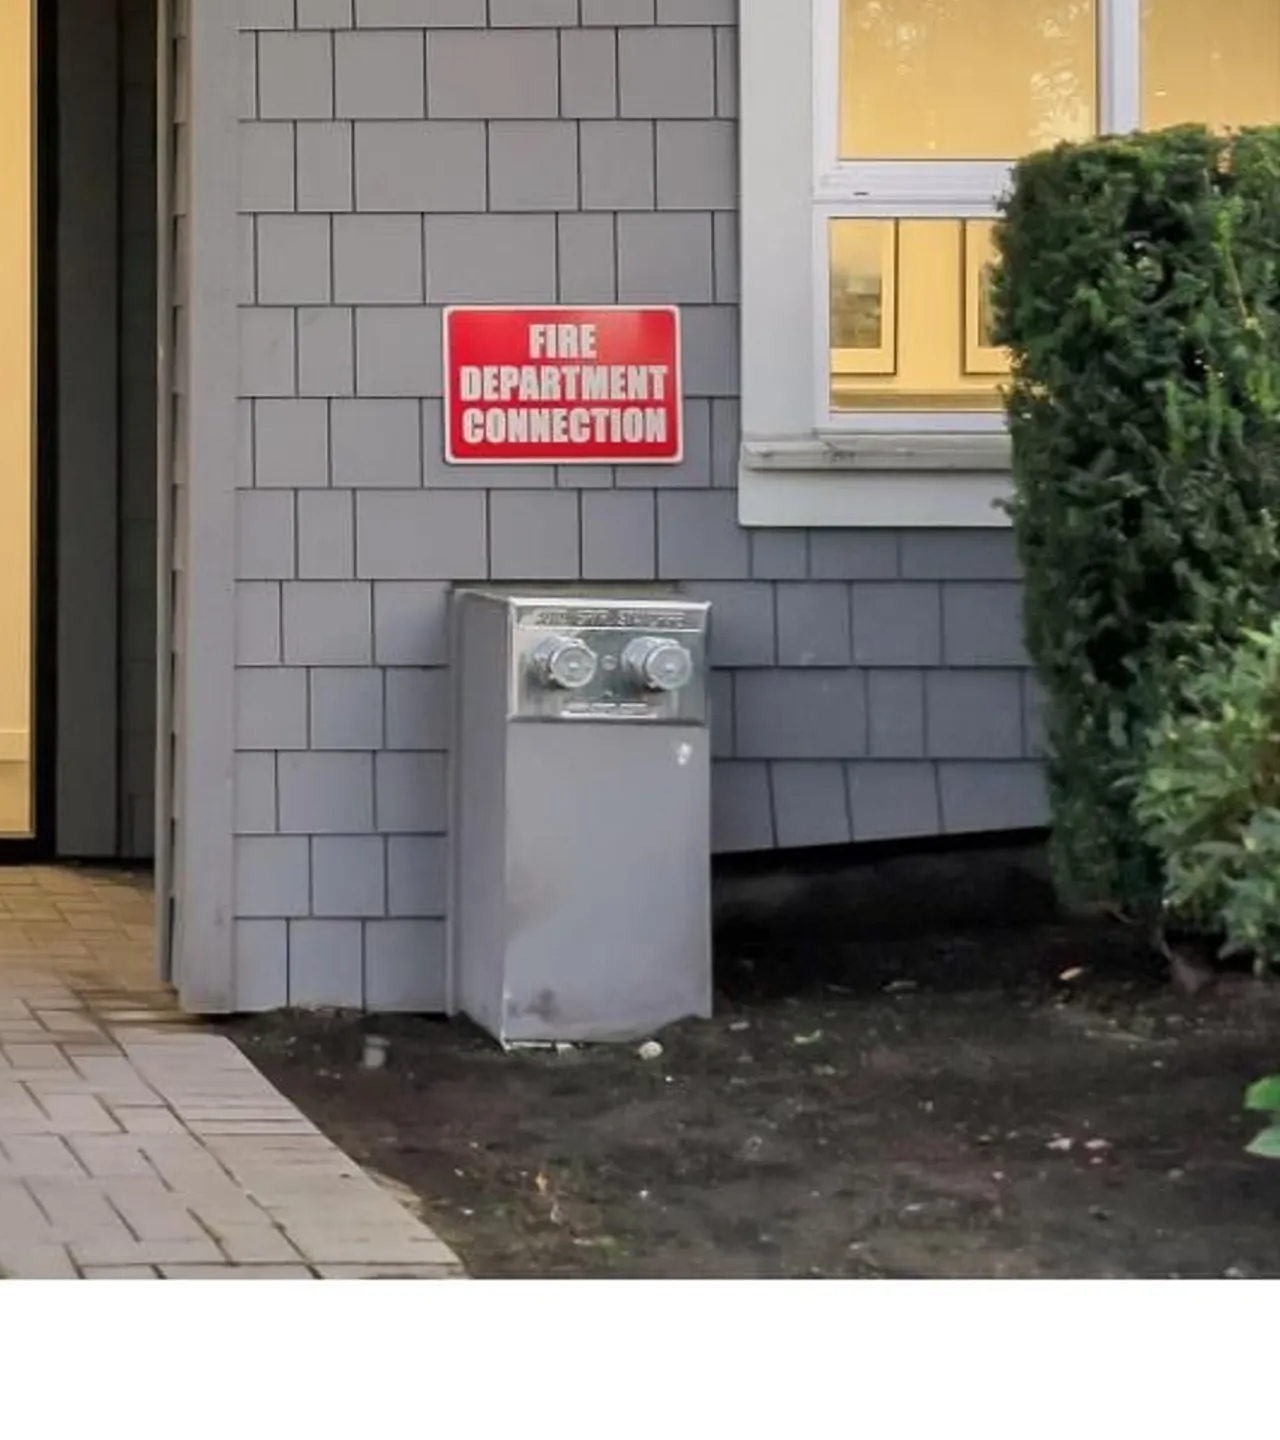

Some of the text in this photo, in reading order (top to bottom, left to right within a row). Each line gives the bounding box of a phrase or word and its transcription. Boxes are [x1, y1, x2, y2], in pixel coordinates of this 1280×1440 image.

[528, 323, 598, 360] FIRE
[459, 364, 668, 402] DEPARTMENT
[462, 407, 668, 443] CONNECTION
